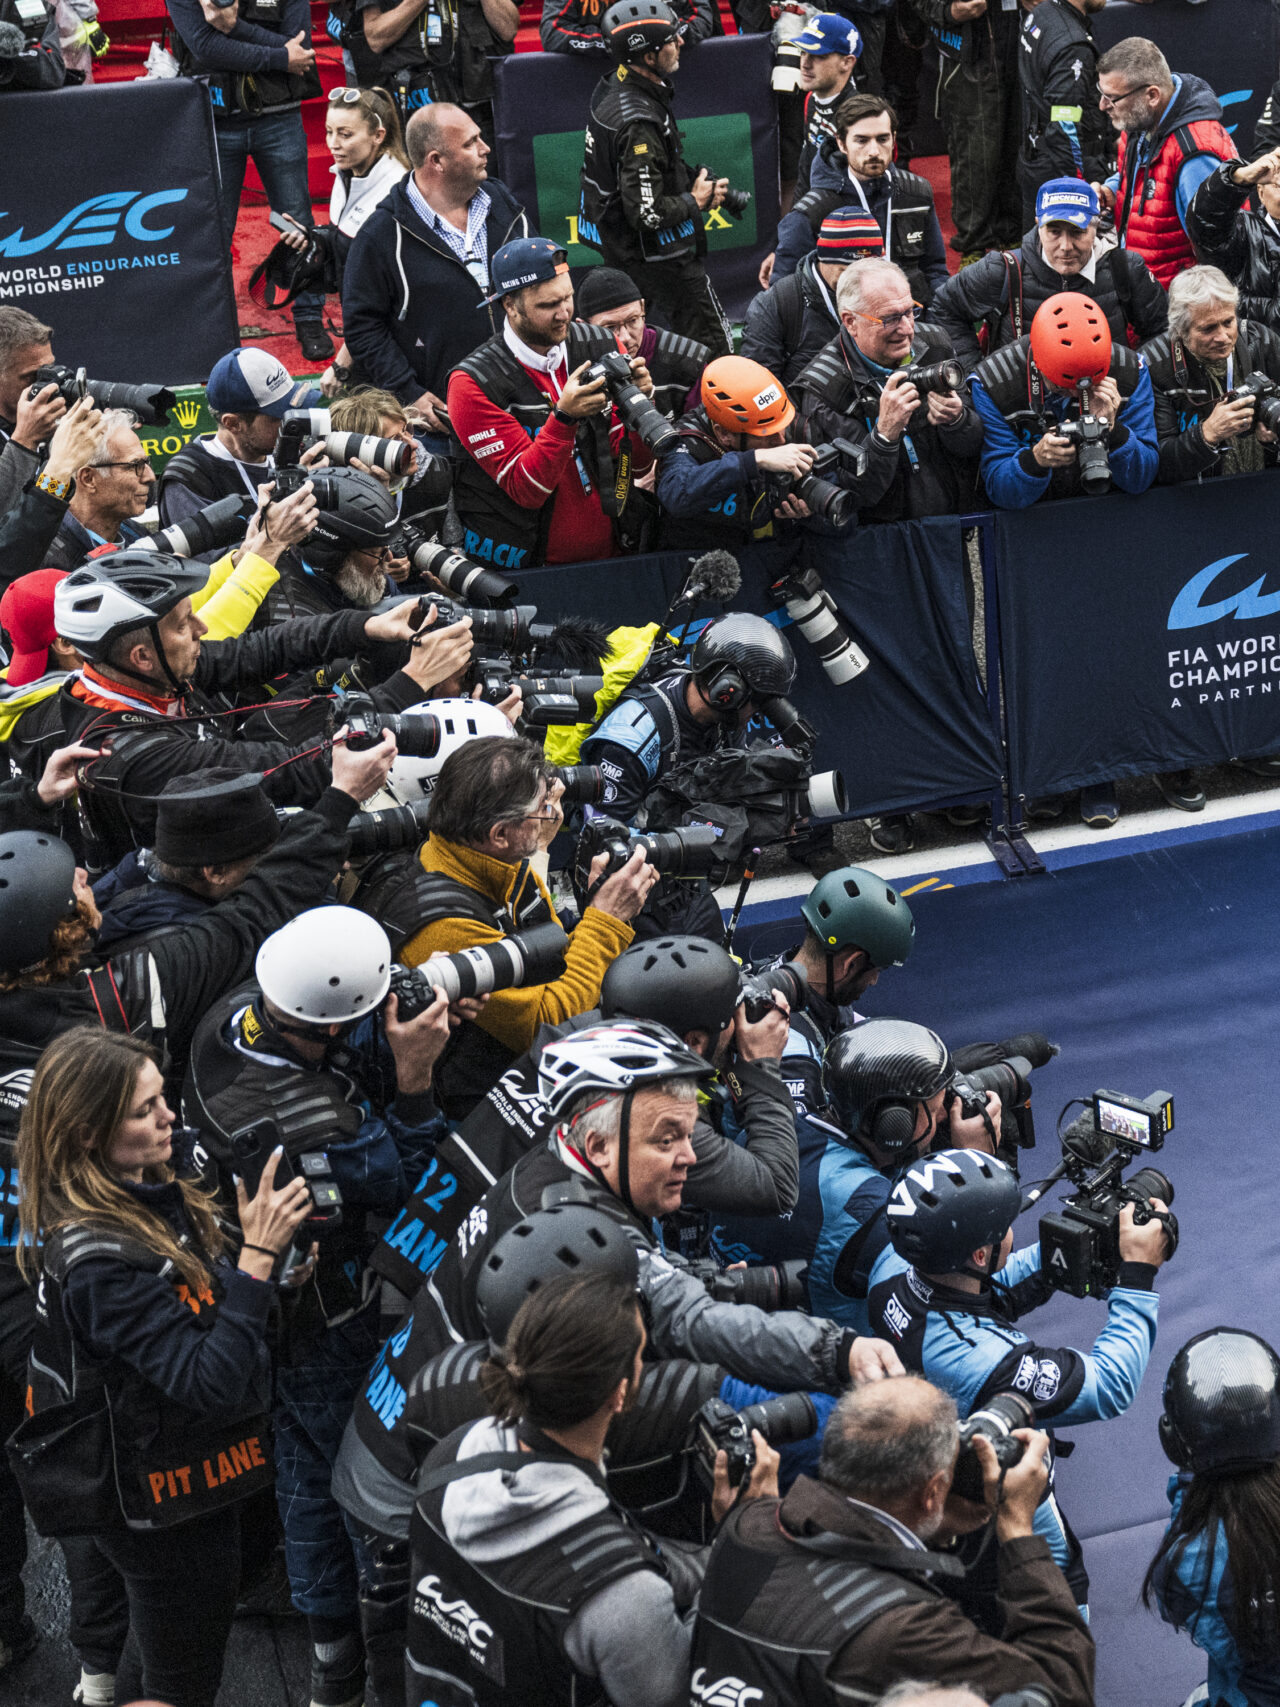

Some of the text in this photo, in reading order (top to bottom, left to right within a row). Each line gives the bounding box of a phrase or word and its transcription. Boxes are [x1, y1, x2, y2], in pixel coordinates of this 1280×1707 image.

[1049, 194, 1088, 204] MICHELIN
[678, 218, 696, 239] LAN
[67, 252, 181, 276] ENDURANCE
[0, 275, 104, 299] MPIONSHIP
[502, 273, 538, 290] RACING TEAM
[757, 389, 778, 407] dppi
[468, 428, 498, 445] MAHLE
[474, 440, 505, 459] PIRELLI
[618, 453, 630, 478] Nikon
[464, 527, 528, 569] RACK
[849, 653, 862, 669] dppi
[1168, 647, 1208, 668] FIA
[1171, 697, 1182, 708] A
[601, 761, 623, 779] OMP
[727, 1071, 743, 1096] EOS
[785, 1082, 805, 1095] MP
[488, 1091, 517, 1126] MPIONSHIP
[492, 1086, 536, 1139] WORLD ENDURANCE
[886, 1298, 909, 1330] OMP
[1016, 1355, 1036, 1390] OMP
[148, 1437, 266, 1504] PIT LANE
[416, 1574, 494, 1649] WEC
